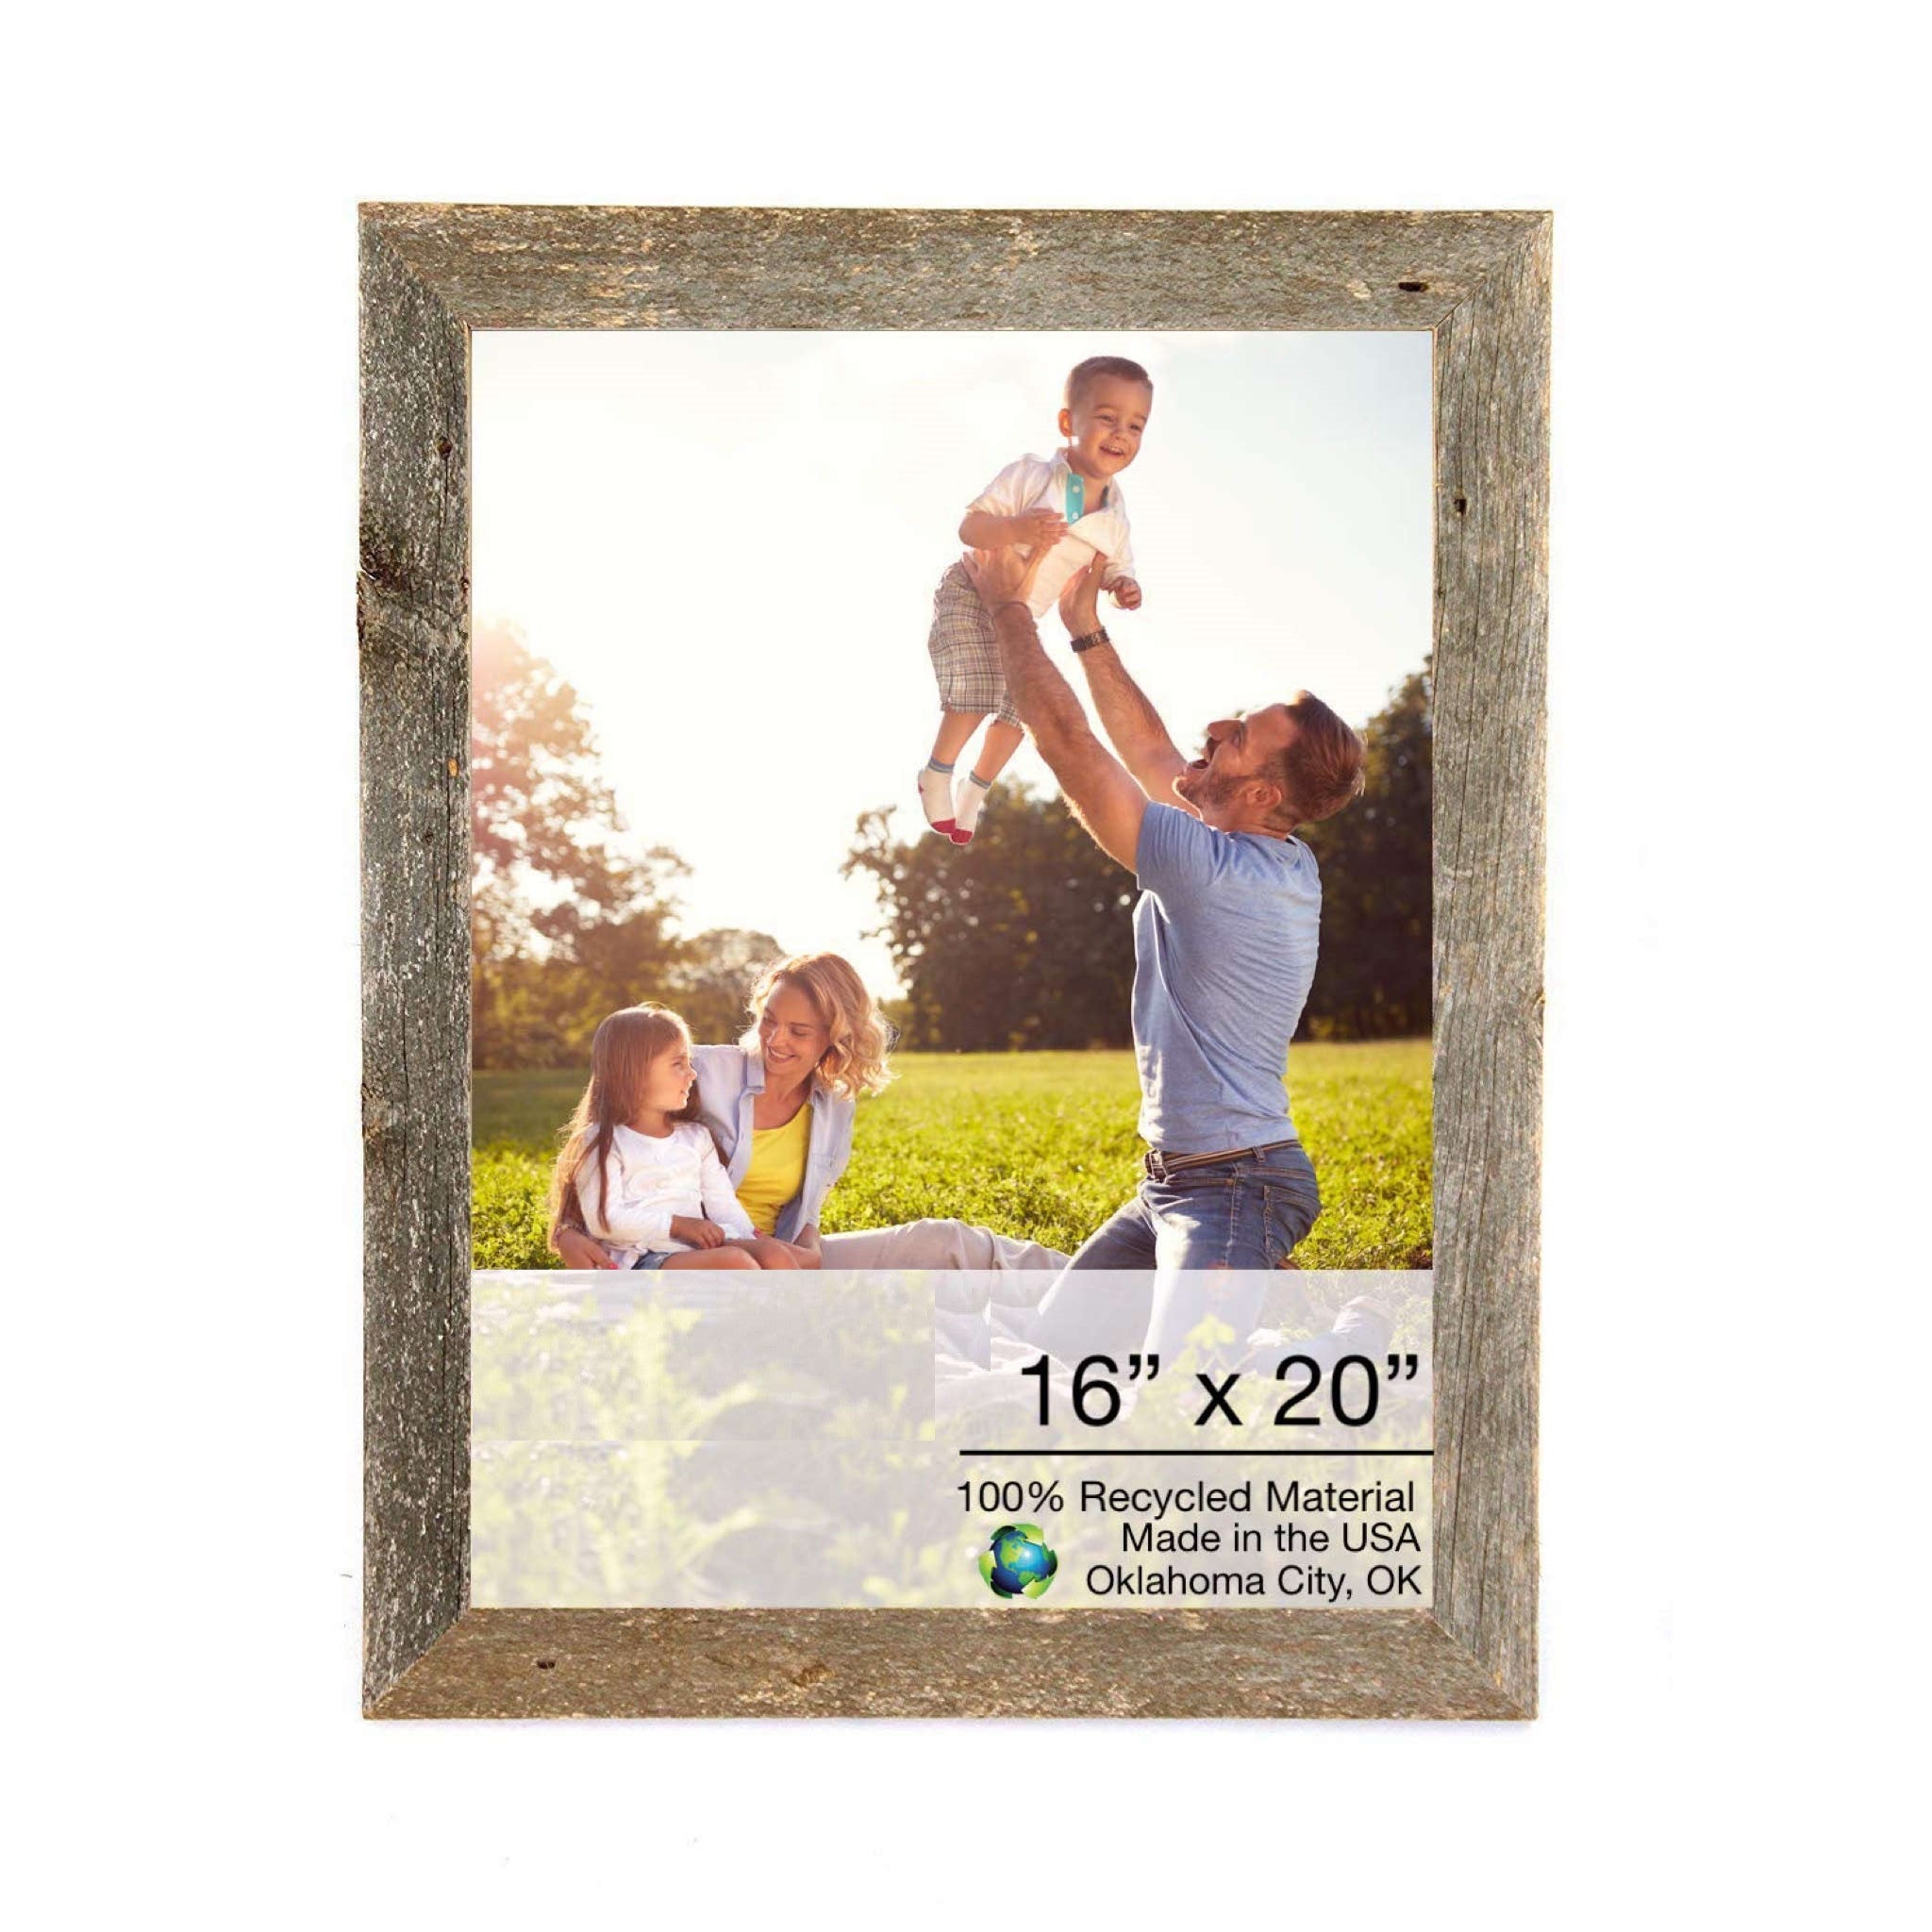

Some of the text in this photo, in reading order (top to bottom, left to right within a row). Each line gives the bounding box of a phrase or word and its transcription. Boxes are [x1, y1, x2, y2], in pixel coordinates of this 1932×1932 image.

[1194, 1374, 1243, 1425] x
[958, 1480, 1414, 1520] 100% Recycled Material
[1123, 1522, 1422, 1553] Made in the USA
[1087, 1564, 1422, 1603] Oklahoma City, OK
